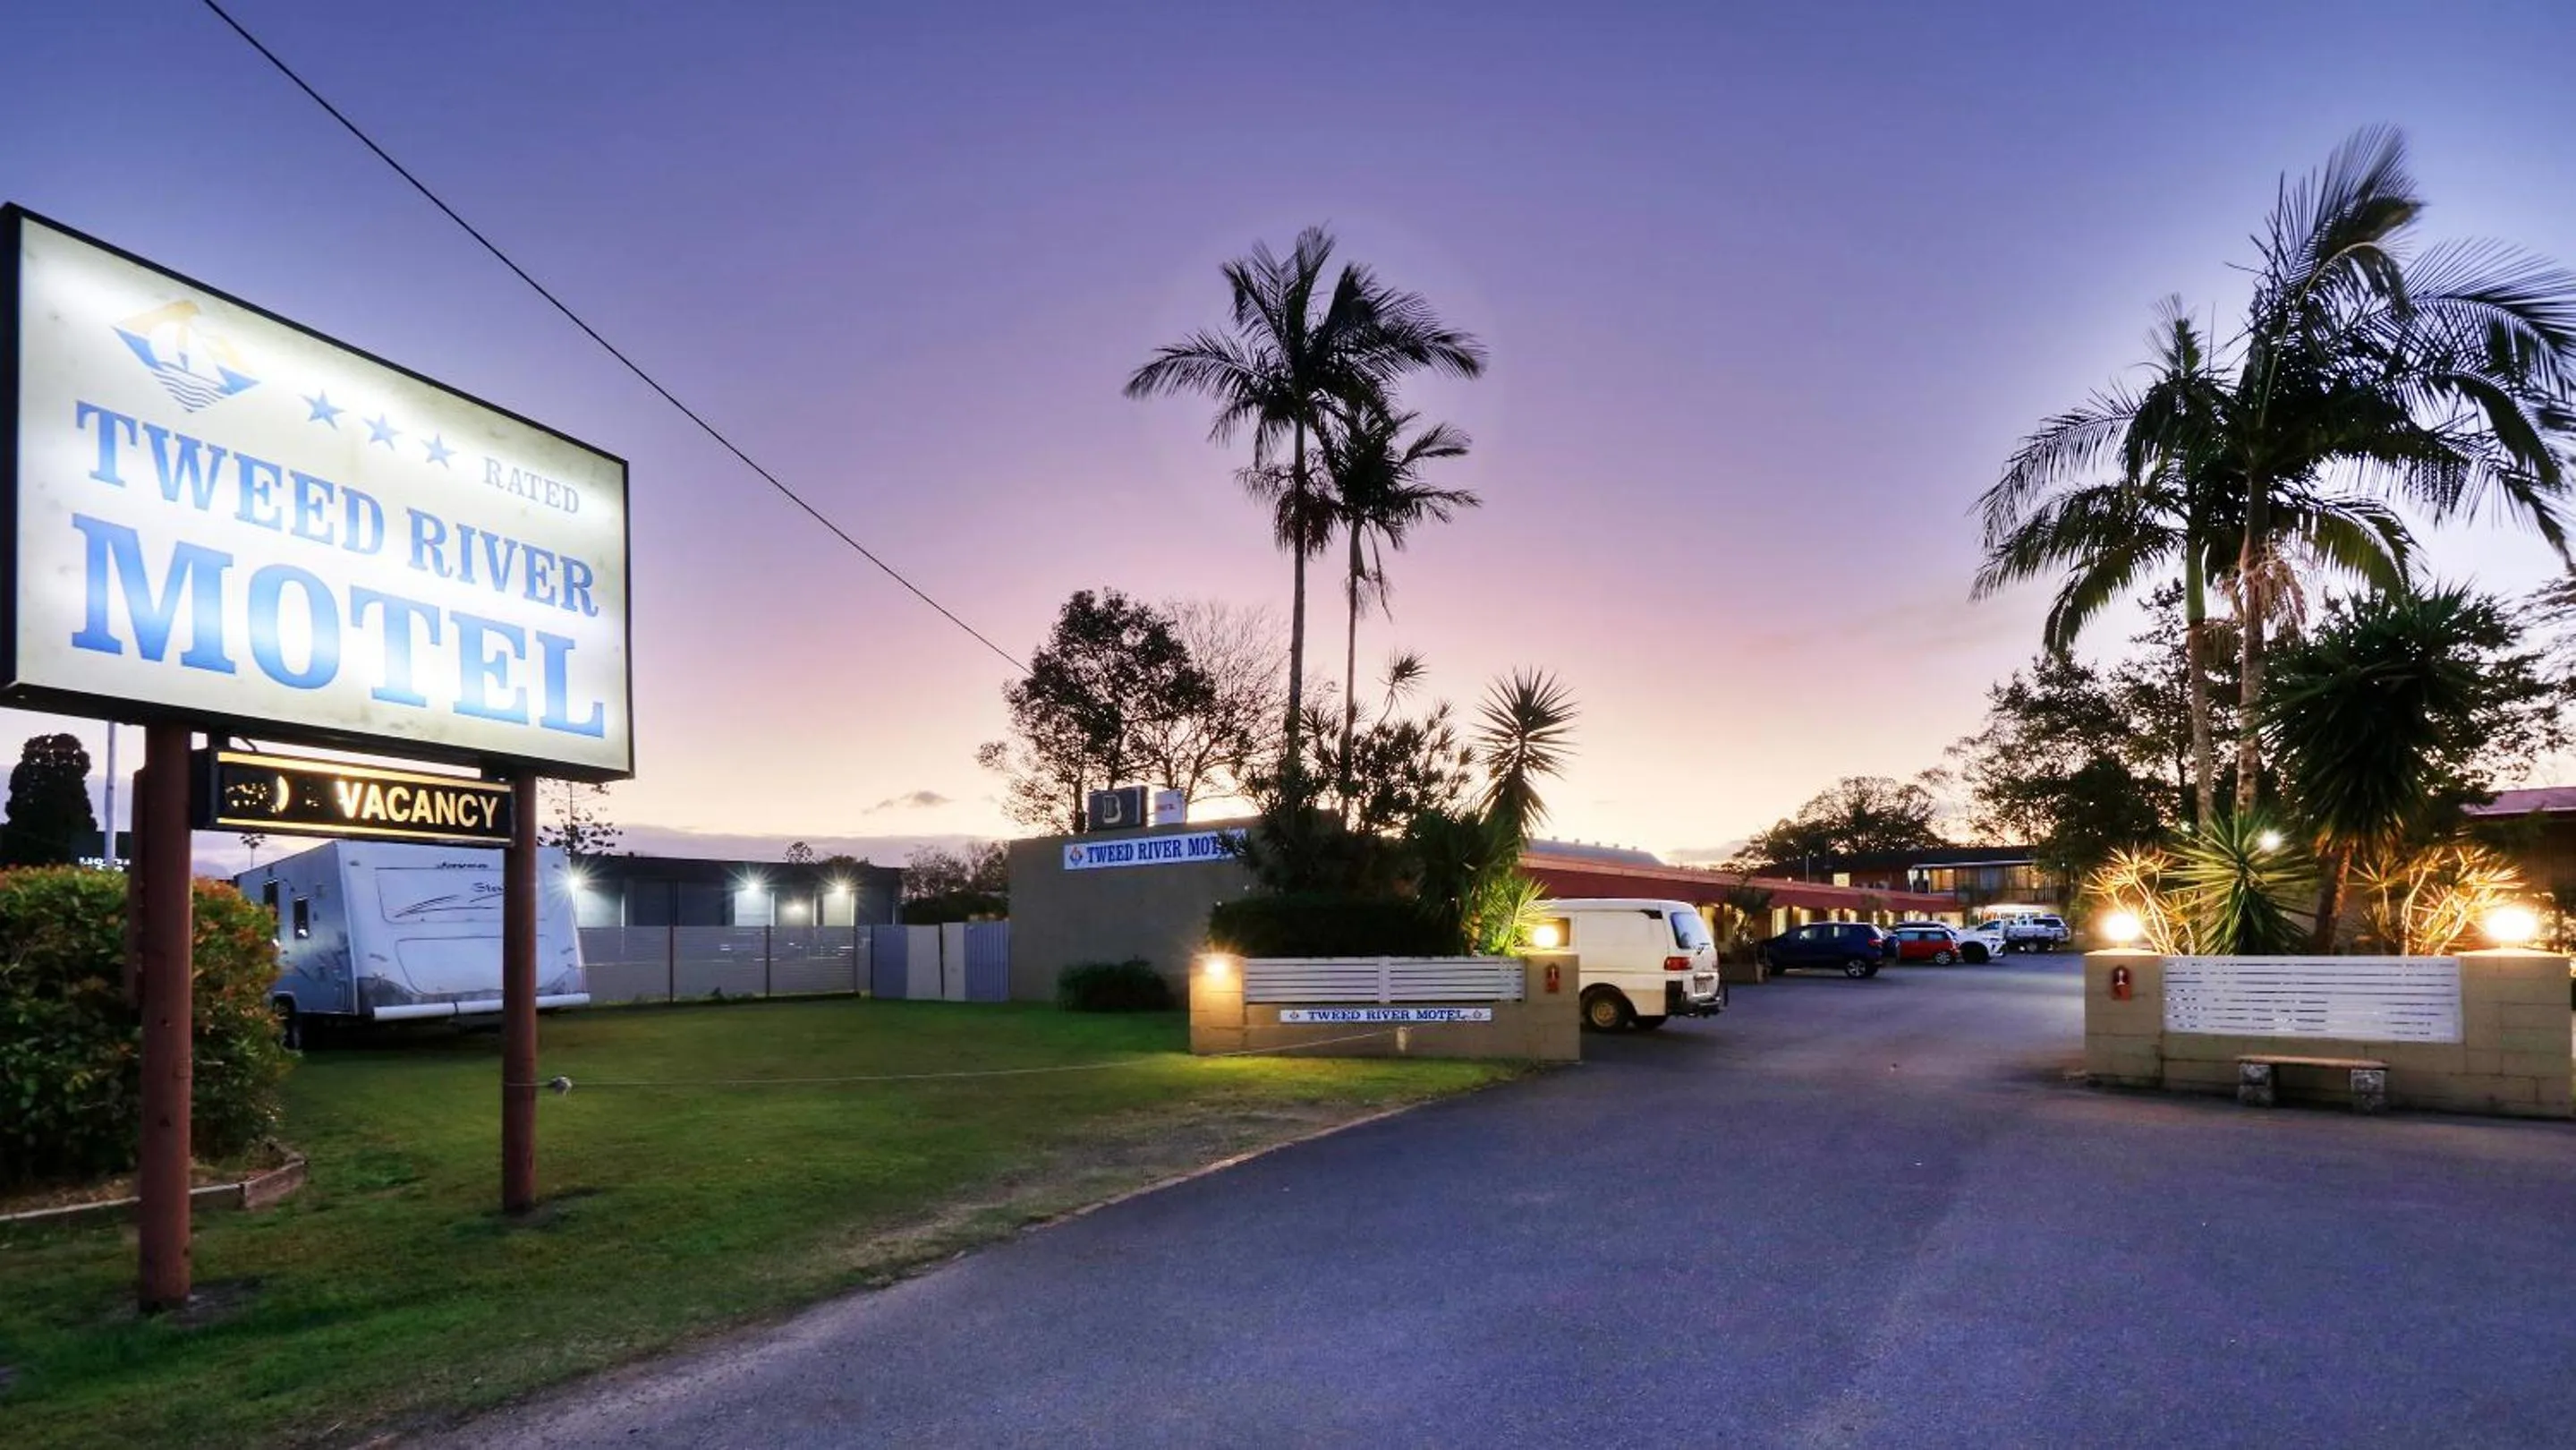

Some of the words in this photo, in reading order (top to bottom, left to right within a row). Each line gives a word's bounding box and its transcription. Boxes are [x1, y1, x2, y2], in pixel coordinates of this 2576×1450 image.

[76, 400, 385, 555] TWEED
[405, 506, 599, 618] RIVER
[482, 456, 580, 514] RATED
[71, 512, 605, 738] MOTEL
[336, 779, 498, 829] VACANCY
[1085, 844, 1134, 865] TWEED
[1138, 839, 1182, 860] RIVER
[1187, 832, 1232, 857] MOT
[1308, 1010, 1361, 1021] TWEED
[1366, 1009, 1411, 1020] RIVER
[1416, 1008, 1466, 1020] MOTEL
